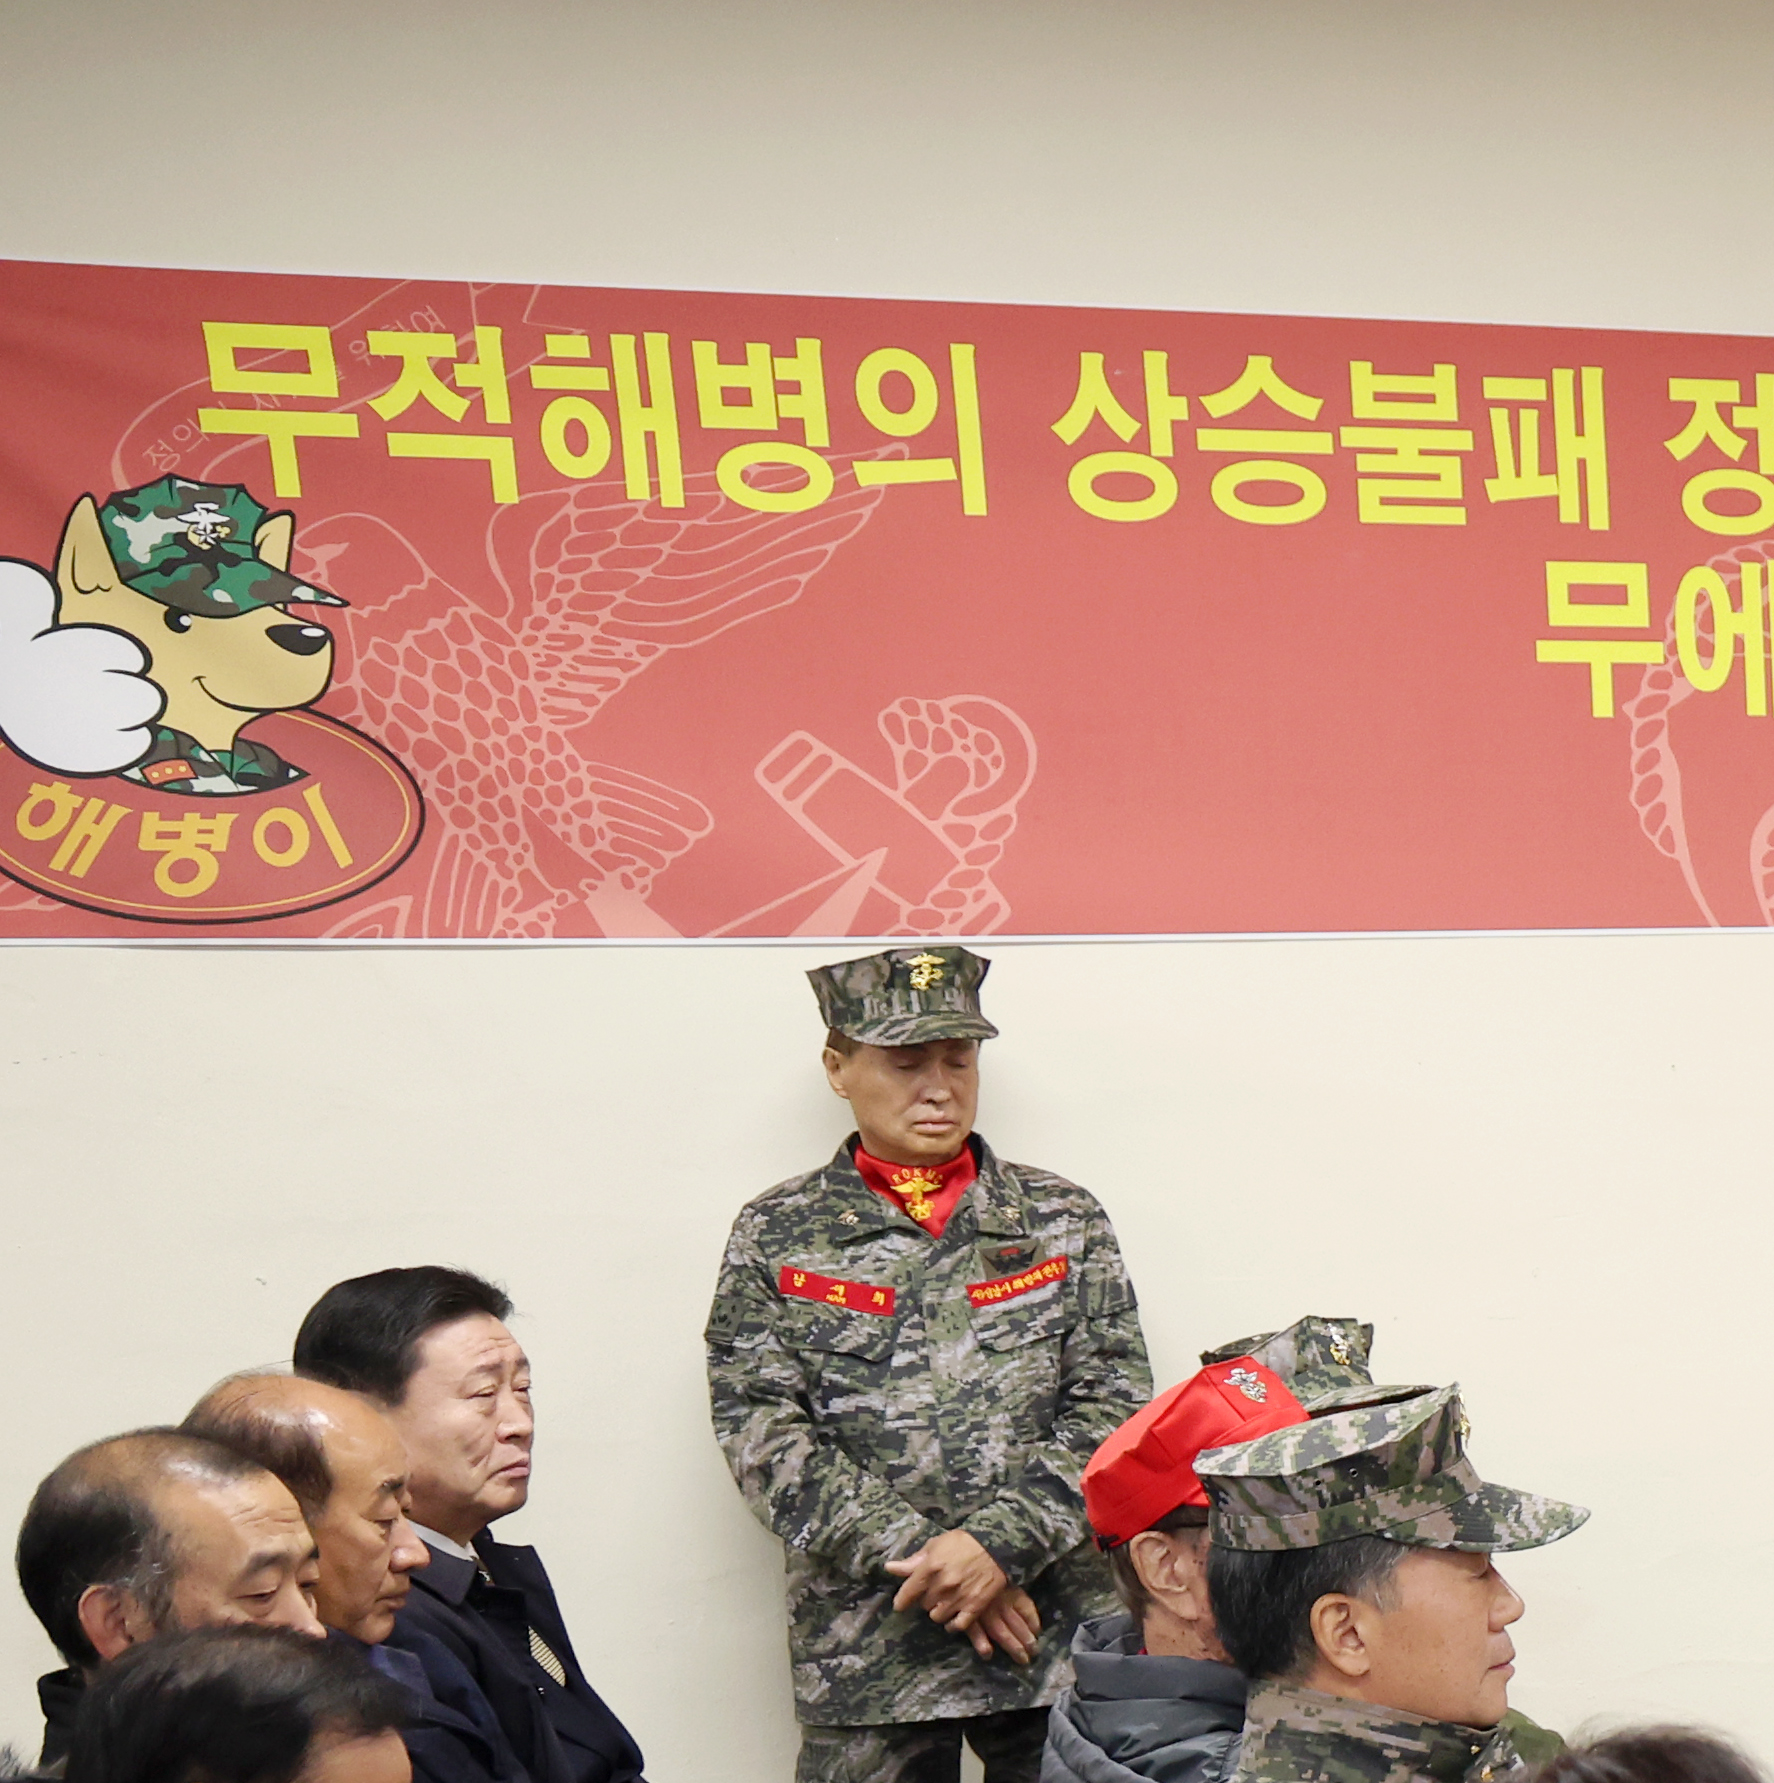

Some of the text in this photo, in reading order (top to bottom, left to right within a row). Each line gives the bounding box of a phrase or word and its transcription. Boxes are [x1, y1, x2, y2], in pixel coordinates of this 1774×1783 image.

[143, 400, 228, 472] 정의
[198, 322, 987, 515] 무적해병의
[1051, 351, 1609, 529] 상승불패
[15, 780, 353, 897] 해병이
